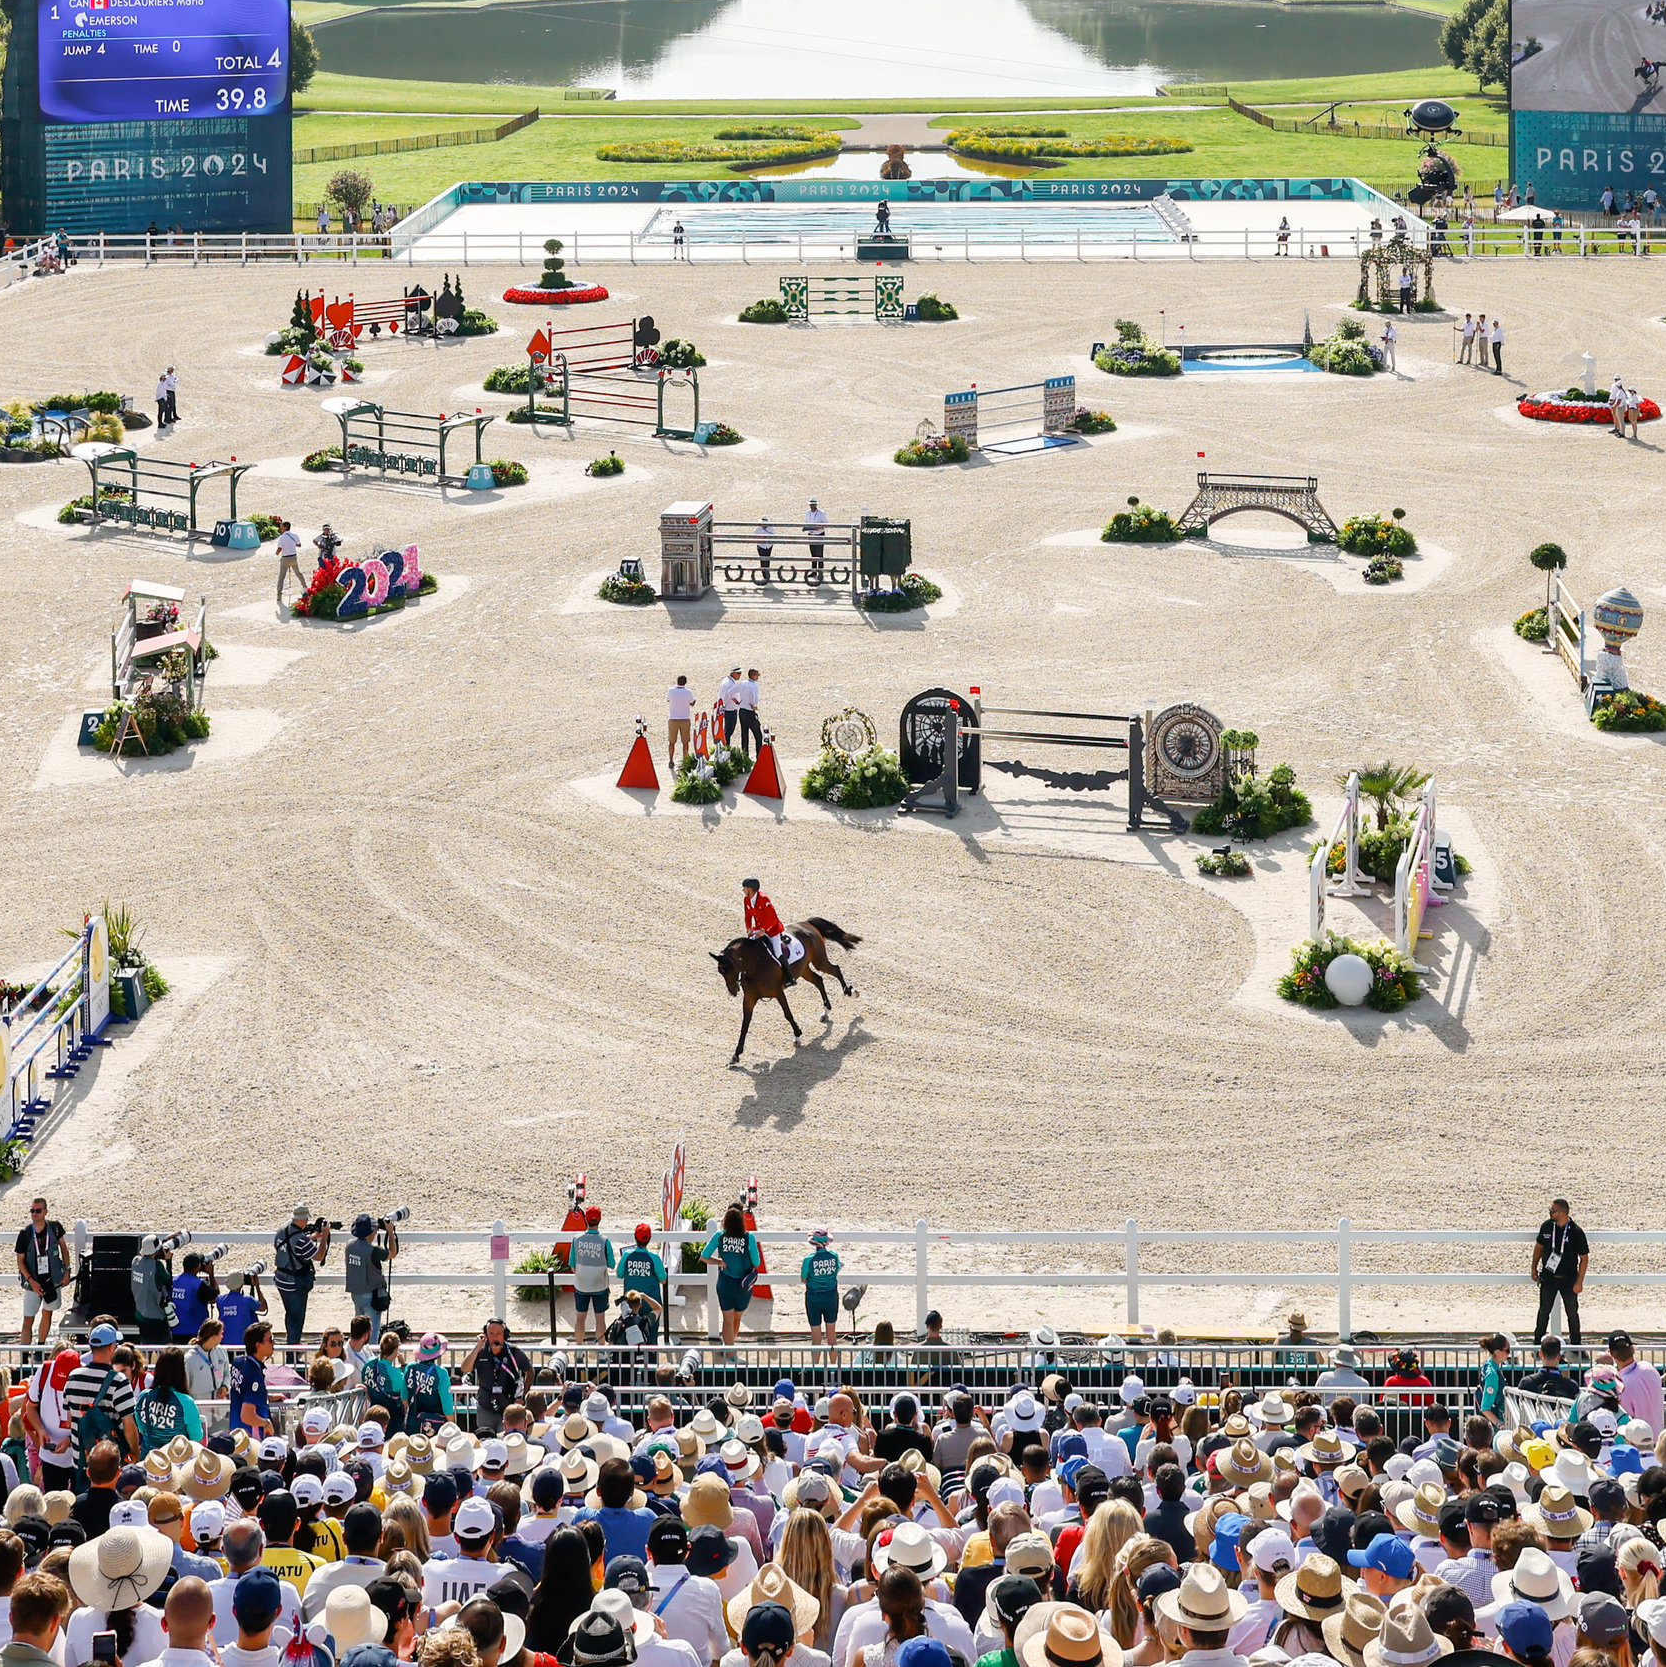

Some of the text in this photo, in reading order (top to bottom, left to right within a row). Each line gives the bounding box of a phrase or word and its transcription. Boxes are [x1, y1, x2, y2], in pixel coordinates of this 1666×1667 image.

[50, 6, 59, 20] 1
[89, 15, 138, 26] EMERSON
[62, 29, 107, 38] PENALTIES
[63, 43, 106, 56] JUMP 4
[133, 40, 181, 54] TIME 0
[215, 47, 281, 70] TOTAL 4
[155, 88, 267, 113] TIME 39.8
[181, 153, 267, 177] 2024
[598, 186, 639, 196] 2024
[848, 185, 890, 195] 2024
[1101, 185, 1142, 195] 2024
[908, 306, 916, 314] 11
[1096, 344, 1102, 353] 6
[698, 426, 706, 435] C
[472, 470, 479, 480] B
[483, 469, 491, 480] B
[216, 524, 226, 536] 10
[234, 527, 241, 539] A
[247, 527, 255, 539] A
[336, 543, 423, 616] 2024
[87, 716, 99, 732] 2
[1436, 852, 1447, 869] 5
[135, 978, 141, 996] 1
